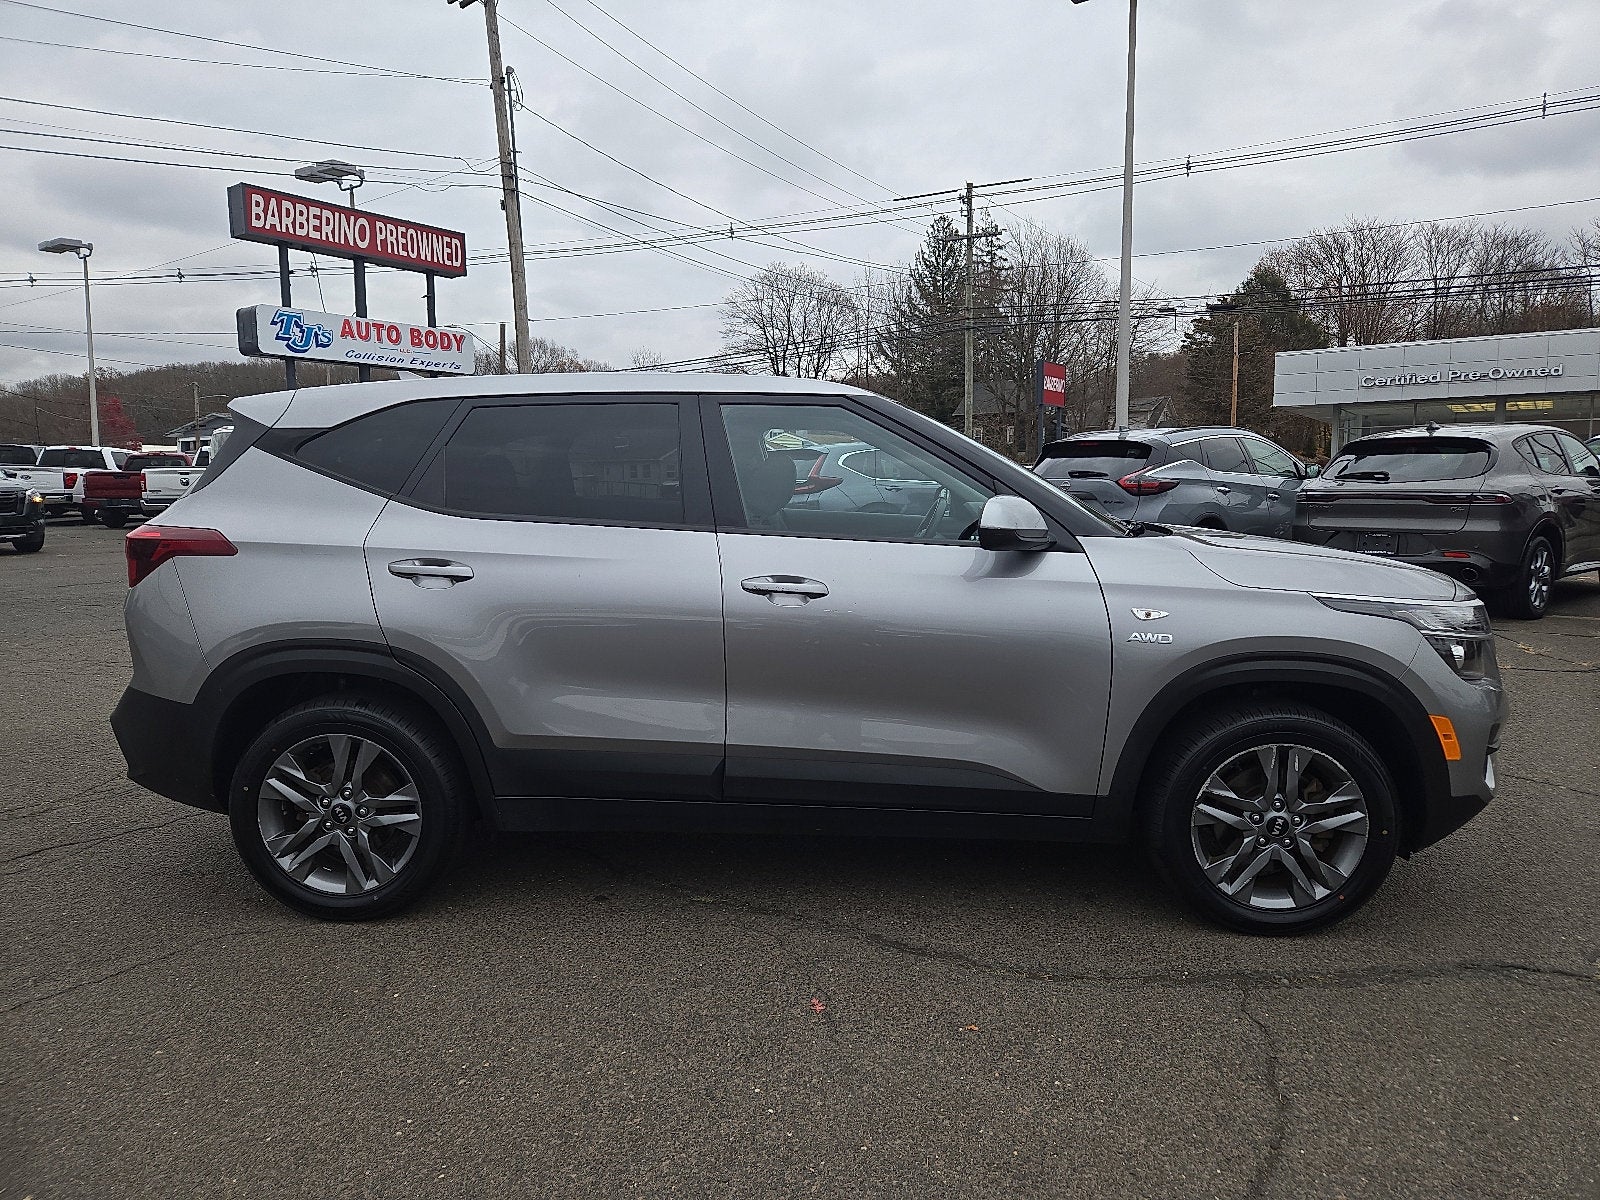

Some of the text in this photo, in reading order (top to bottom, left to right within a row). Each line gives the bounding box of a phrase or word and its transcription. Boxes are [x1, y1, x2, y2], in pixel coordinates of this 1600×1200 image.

[251, 193, 462, 268] BARBERINO PREOWNED
[340, 318, 465, 353] AUTO BODY
[345, 349, 461, 370] Collision Experts
[1361, 363, 1563, 387] Certified Pre-Owned
[1125, 632, 1173, 644] AWD
[334, 805, 348, 823] KIA
[1271, 817, 1284, 835] KIA
